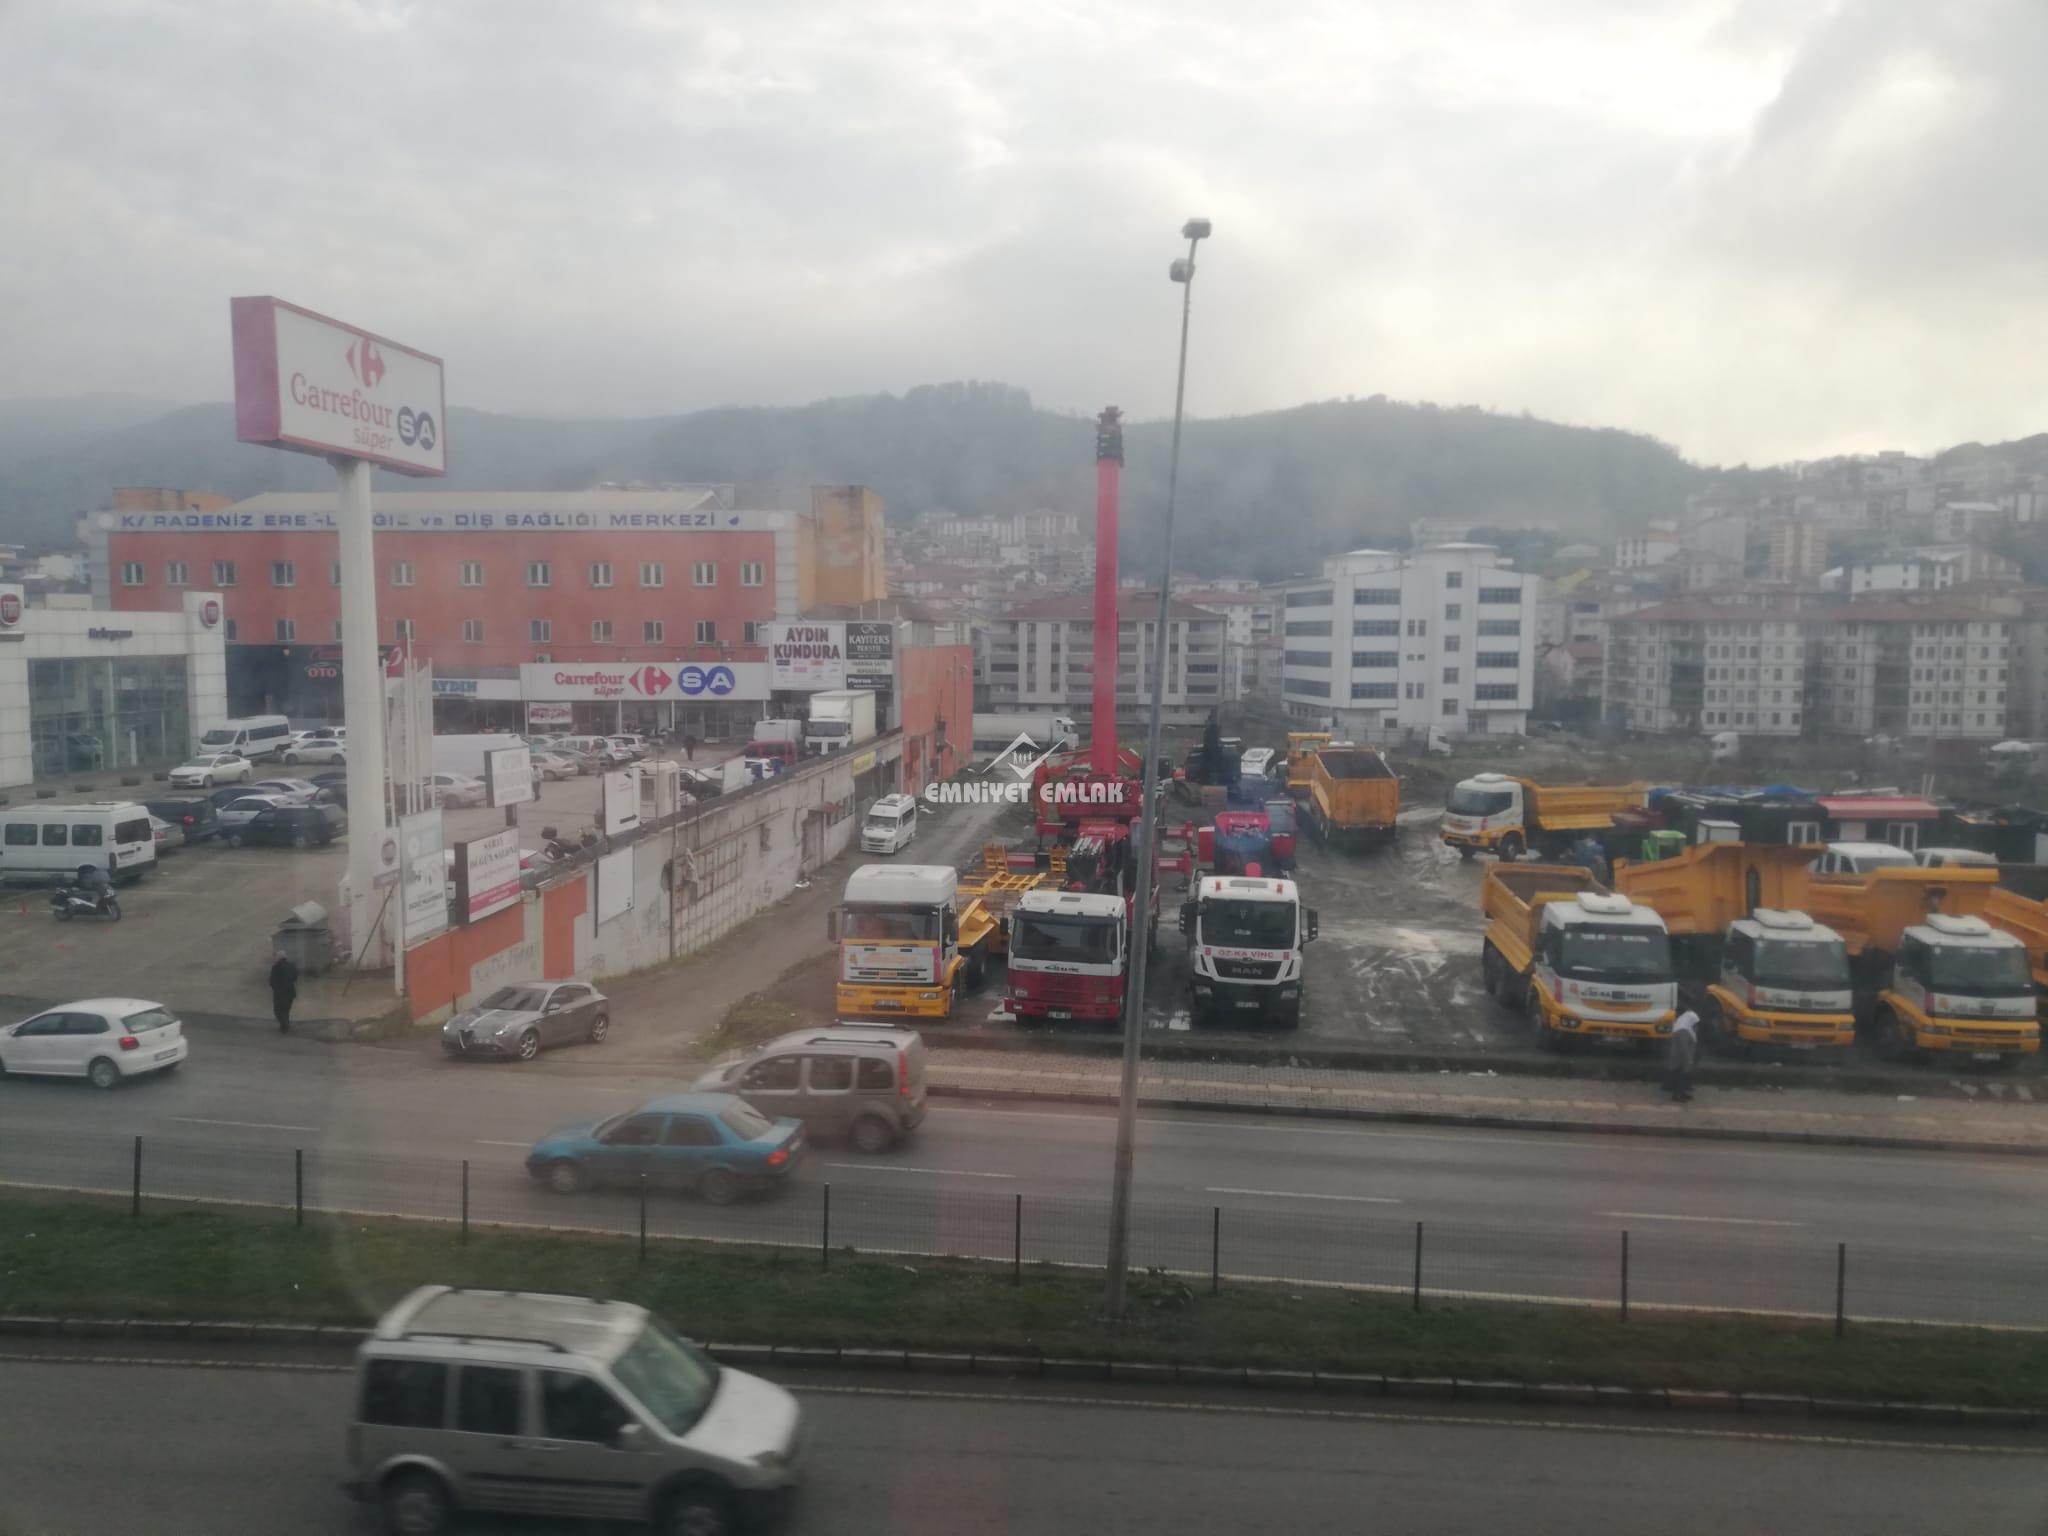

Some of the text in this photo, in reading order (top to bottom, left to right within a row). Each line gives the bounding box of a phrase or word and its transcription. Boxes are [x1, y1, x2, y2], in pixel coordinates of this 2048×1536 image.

[290, 371, 393, 429] Carrefour
[455, 512, 493, 528] DİŞ
[505, 512, 597, 527] SAĞLIĞI
[610, 512, 716, 526] MERKEZİ
[774, 644, 841, 659] KUNDURA
[308, 667, 337, 678] OTO
[554, 671, 625, 686] Carrefour
[593, 686, 625, 697] süper
